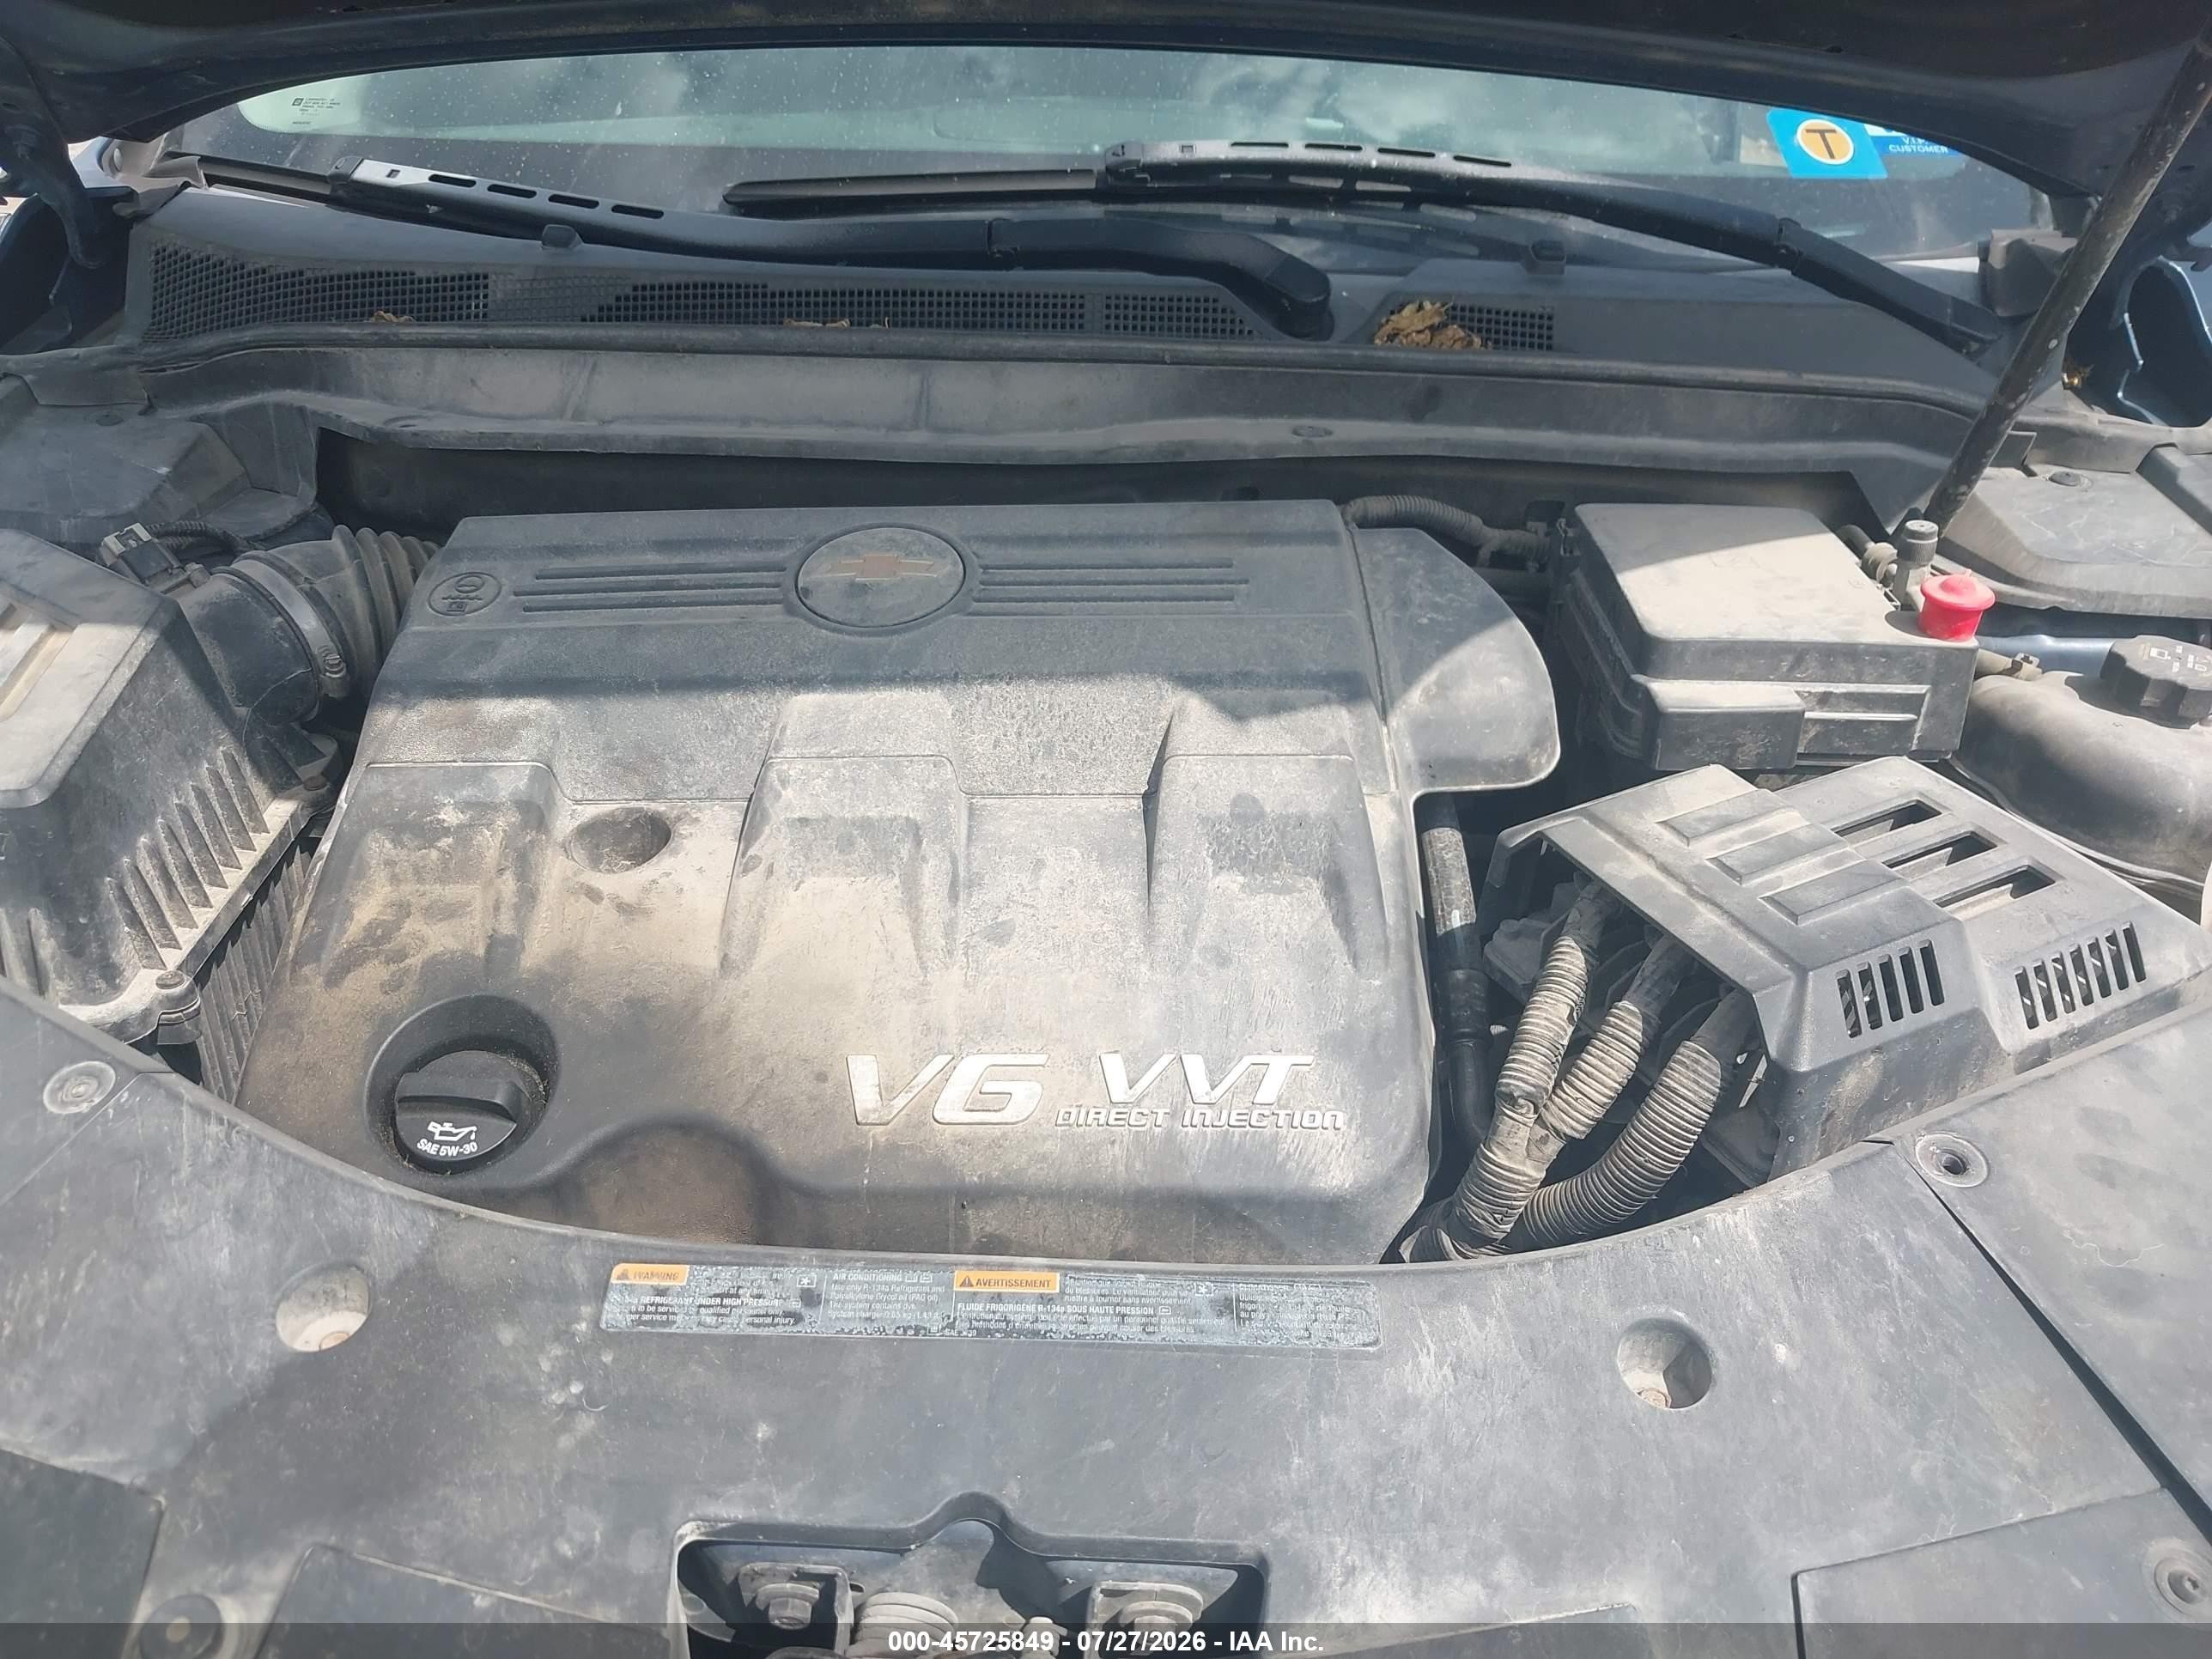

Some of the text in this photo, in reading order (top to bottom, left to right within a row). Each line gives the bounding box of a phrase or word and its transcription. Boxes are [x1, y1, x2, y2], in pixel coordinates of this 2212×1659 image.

[1805, 128, 1837, 160] T
[1888, 144, 1949, 154] CUSTOMER
[846, 1053, 1315, 1126] V6 VVT
[1055, 1108, 1347, 1130] DIRECT INJECTION
[416, 1139, 478, 1157] SAE 5W-30
[832, 1273, 902, 1282] AIR CONDITIONING
[975, 1279, 1051, 1288] AVERTISSEMENT
[722, 1297, 742, 1306] HIGH
[647, 1304, 656, 1313] be
[700, 1306, 730, 1316] qualified
[957, 1303, 984, 1311] FLUIDE
[1116, 1306, 1154, 1315] PRESSION
[774, 1316, 796, 1326] injury.
